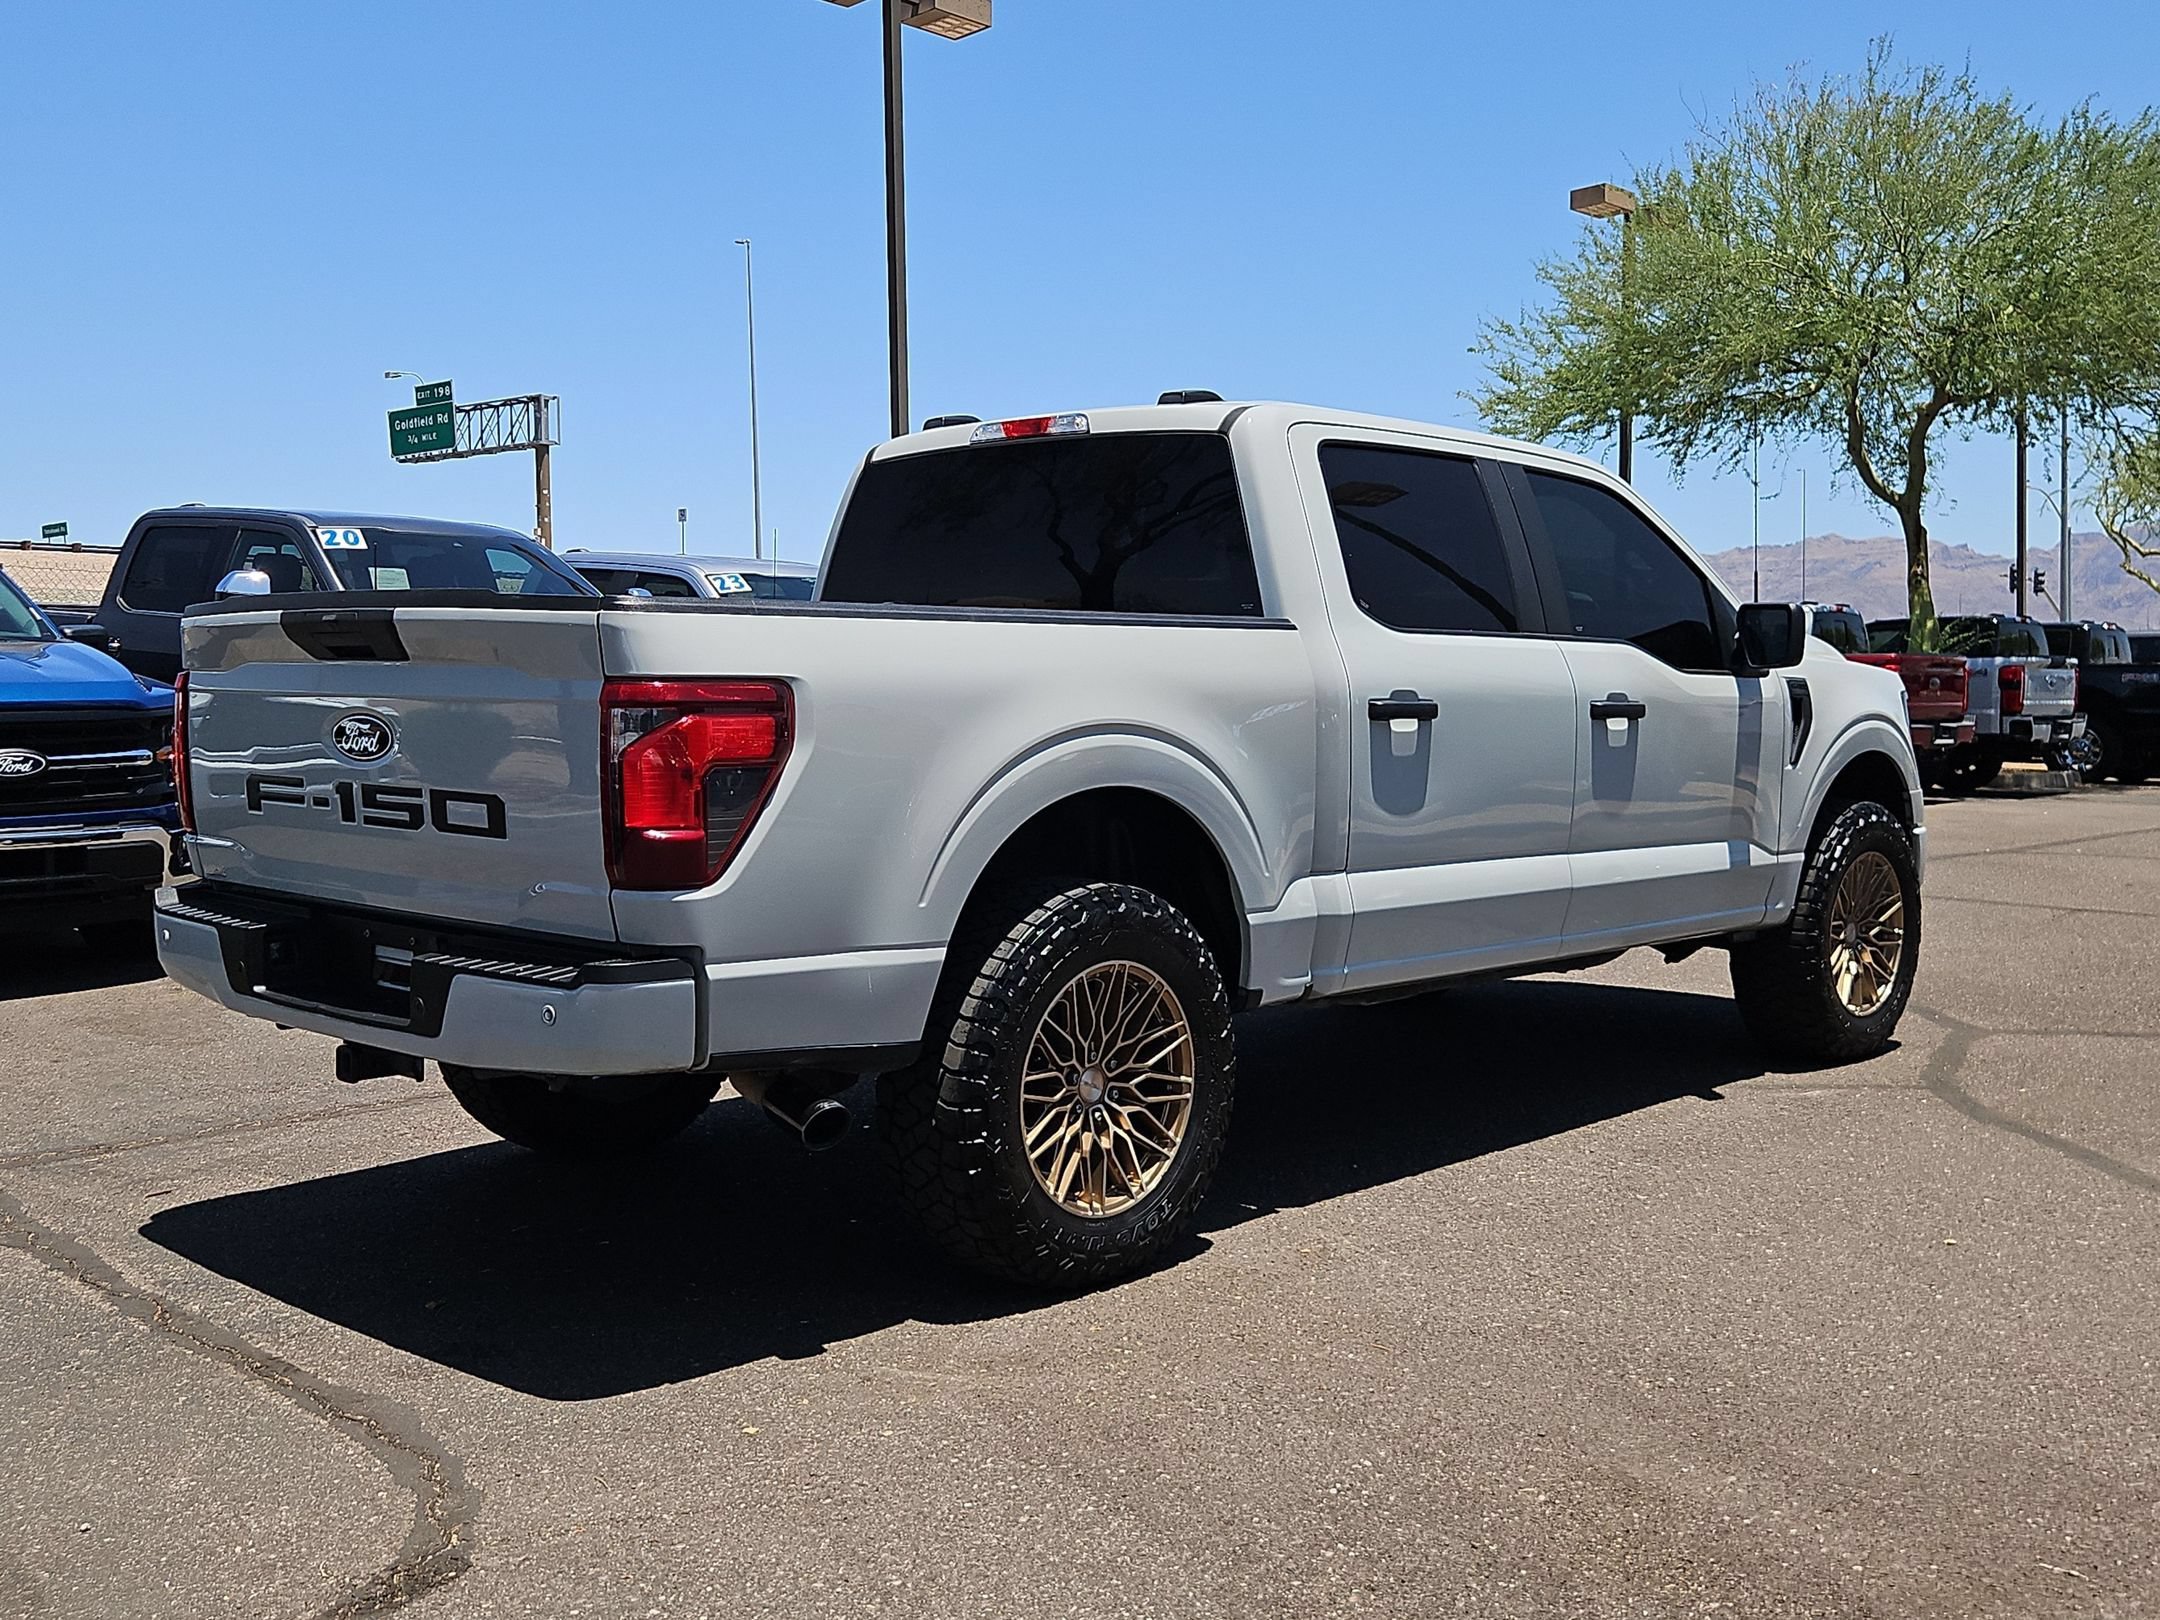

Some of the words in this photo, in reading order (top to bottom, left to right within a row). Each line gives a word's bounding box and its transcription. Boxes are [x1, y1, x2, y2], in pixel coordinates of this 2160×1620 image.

[417, 391, 430, 399] EXIT
[434, 386, 450, 398] 198
[395, 415, 433, 431] Goldfield
[437, 412, 449, 424] Rd
[407, 434, 418, 444] 3/4
[421, 432, 437, 441] MILE
[320, 529, 359, 546] 20
[713, 574, 745, 591] 23
[338, 720, 380, 752] Ford
[0, 756, 34, 773] Ford
[245, 773, 508, 840] F-150
